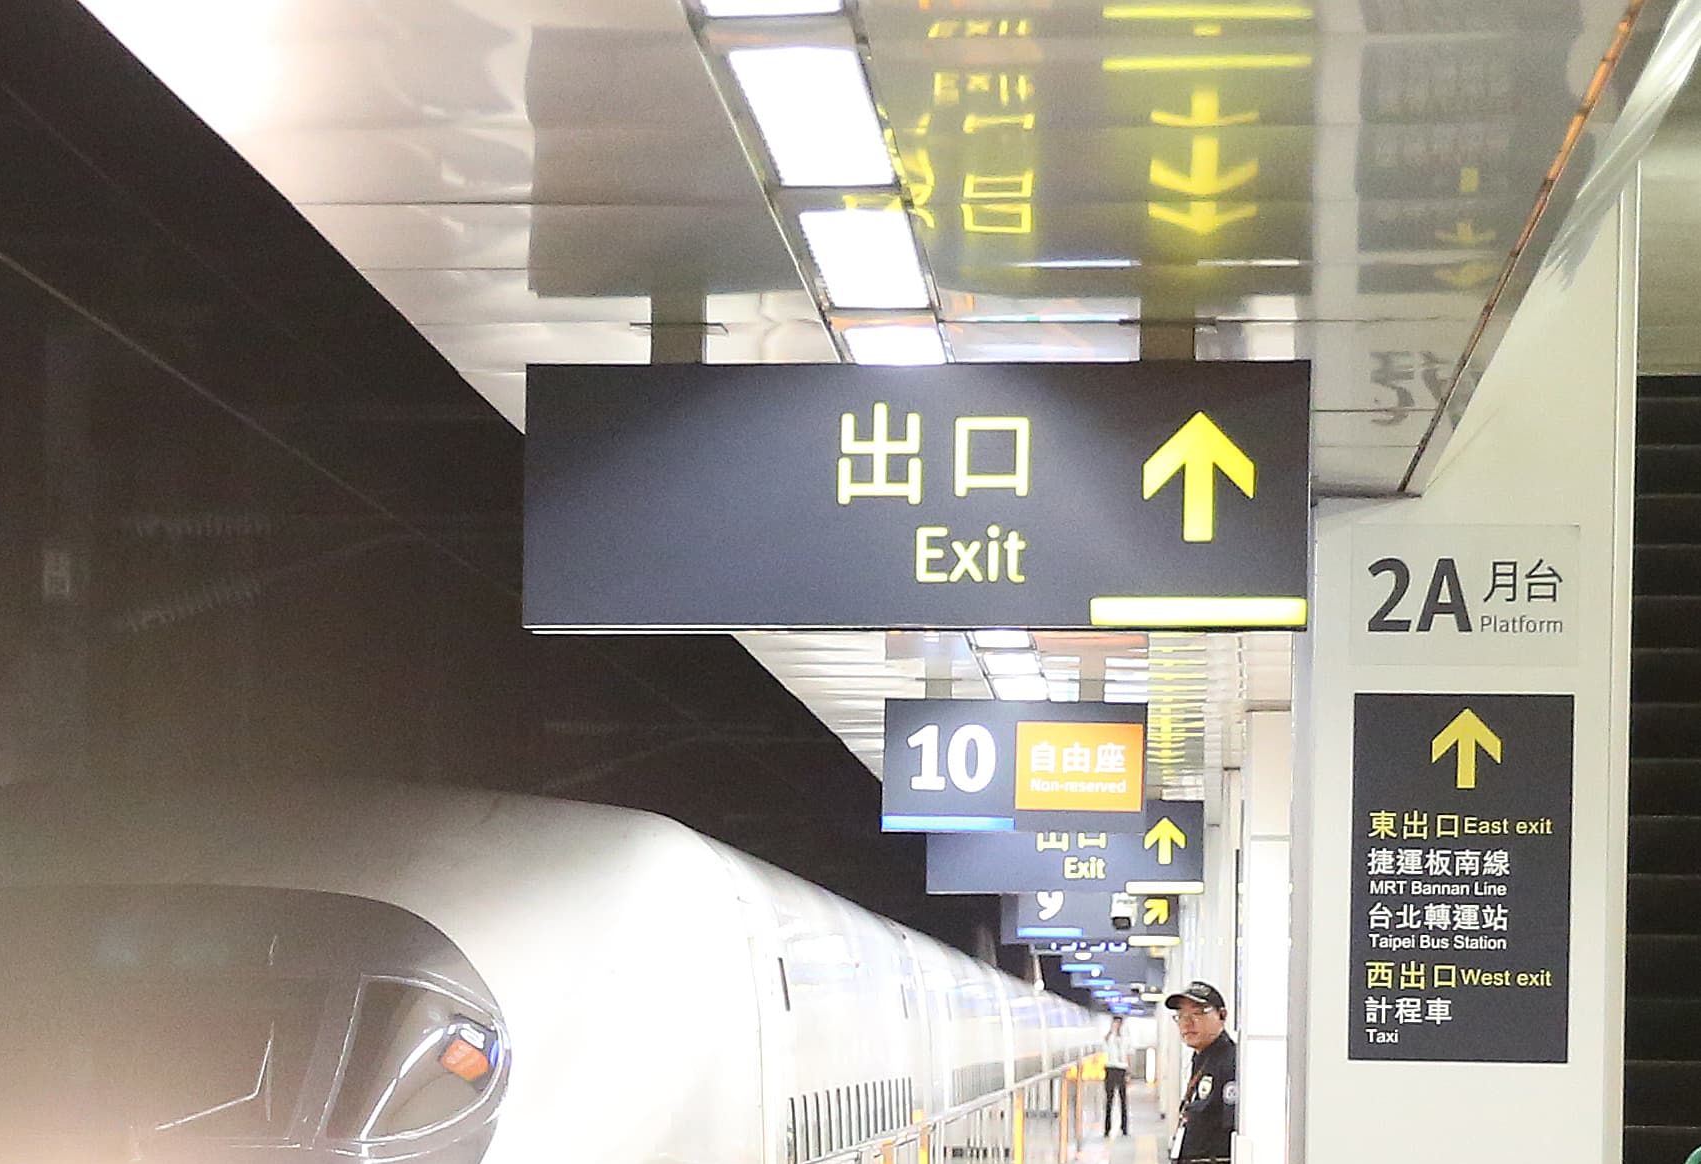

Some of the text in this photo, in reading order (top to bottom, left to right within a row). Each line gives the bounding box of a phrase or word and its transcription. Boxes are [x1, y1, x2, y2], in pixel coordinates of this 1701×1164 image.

[836, 402, 1031, 505] 出口
[915, 525, 1026, 585] Exit
[1367, 557, 1564, 633] 2A 月台
[1480, 615, 1564, 633] Platform
[907, 724, 996, 793] 10
[1030, 740, 1127, 774] 自由座
[1030, 778, 1128, 793] Non-reserved
[1368, 810, 1554, 840] 東出口 East exit
[1063, 856, 1107, 879] Exit
[1367, 848, 1511, 877] 捷運板南線
[1369, 880, 1508, 896] MRT Bannan Line
[1368, 902, 1509, 932] 台北轉運站
[1368, 933, 1508, 951] Taipei Bus Station
[1365, 960, 1553, 990] 西出口 West exit
[1364, 996, 1452, 1025] 計程車
[1365, 1029, 1399, 1044] Taxi
